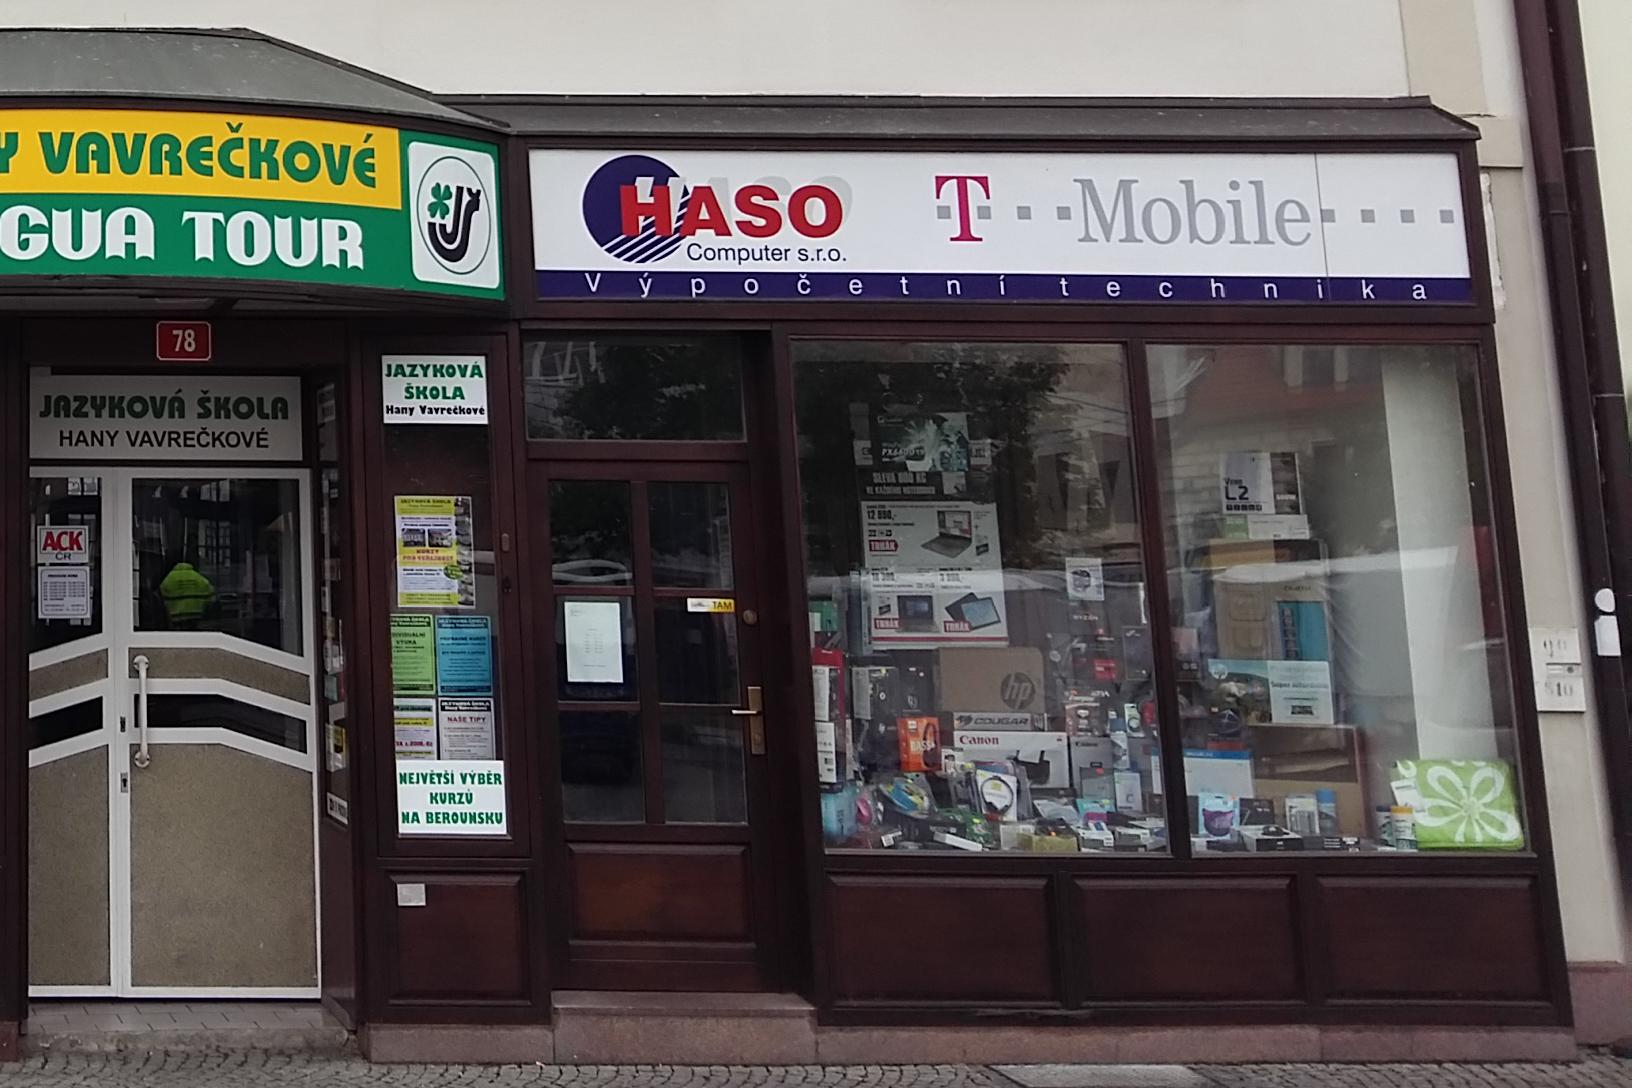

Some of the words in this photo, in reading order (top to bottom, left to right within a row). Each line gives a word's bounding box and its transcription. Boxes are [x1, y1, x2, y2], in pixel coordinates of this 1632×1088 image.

[38, 121, 377, 190] VAVREČKOVÉ
[620, 184, 844, 238] HASO
[1072, 178, 1312, 246] Mobile
[181, 210, 364, 271] TOUR
[686, 243, 792, 265] Computer
[797, 248, 847, 263] s.r.o.
[173, 329, 197, 352] 78
[385, 361, 484, 379] JAZYKOVÁ
[404, 382, 465, 400] ŠKOLA
[39, 389, 186, 420] JAZYKOVÁ
[196, 389, 289, 421] ŠKOLA
[386, 404, 415, 416] Hany
[419, 404, 486, 416] Vavrečkové
[59, 429, 119, 448] HANY
[126, 426, 270, 449] VAVREČKOVÉ
[1225, 485, 1249, 501] L2
[42, 530, 83, 552] ACK
[711, 600, 733, 610] TAM
[1003, 672, 1033, 709] hp
[973, 715, 1029, 726] COUGAR
[959, 734, 1000, 745] Canon
[399, 770, 455, 785] NEJVĚTŠÍ
[460, 770, 502, 785] VÝBĚR
[429, 789, 473, 804] KURZŮ
[401, 811, 421, 824] NA
[426, 811, 503, 824] BEROUNSKU
